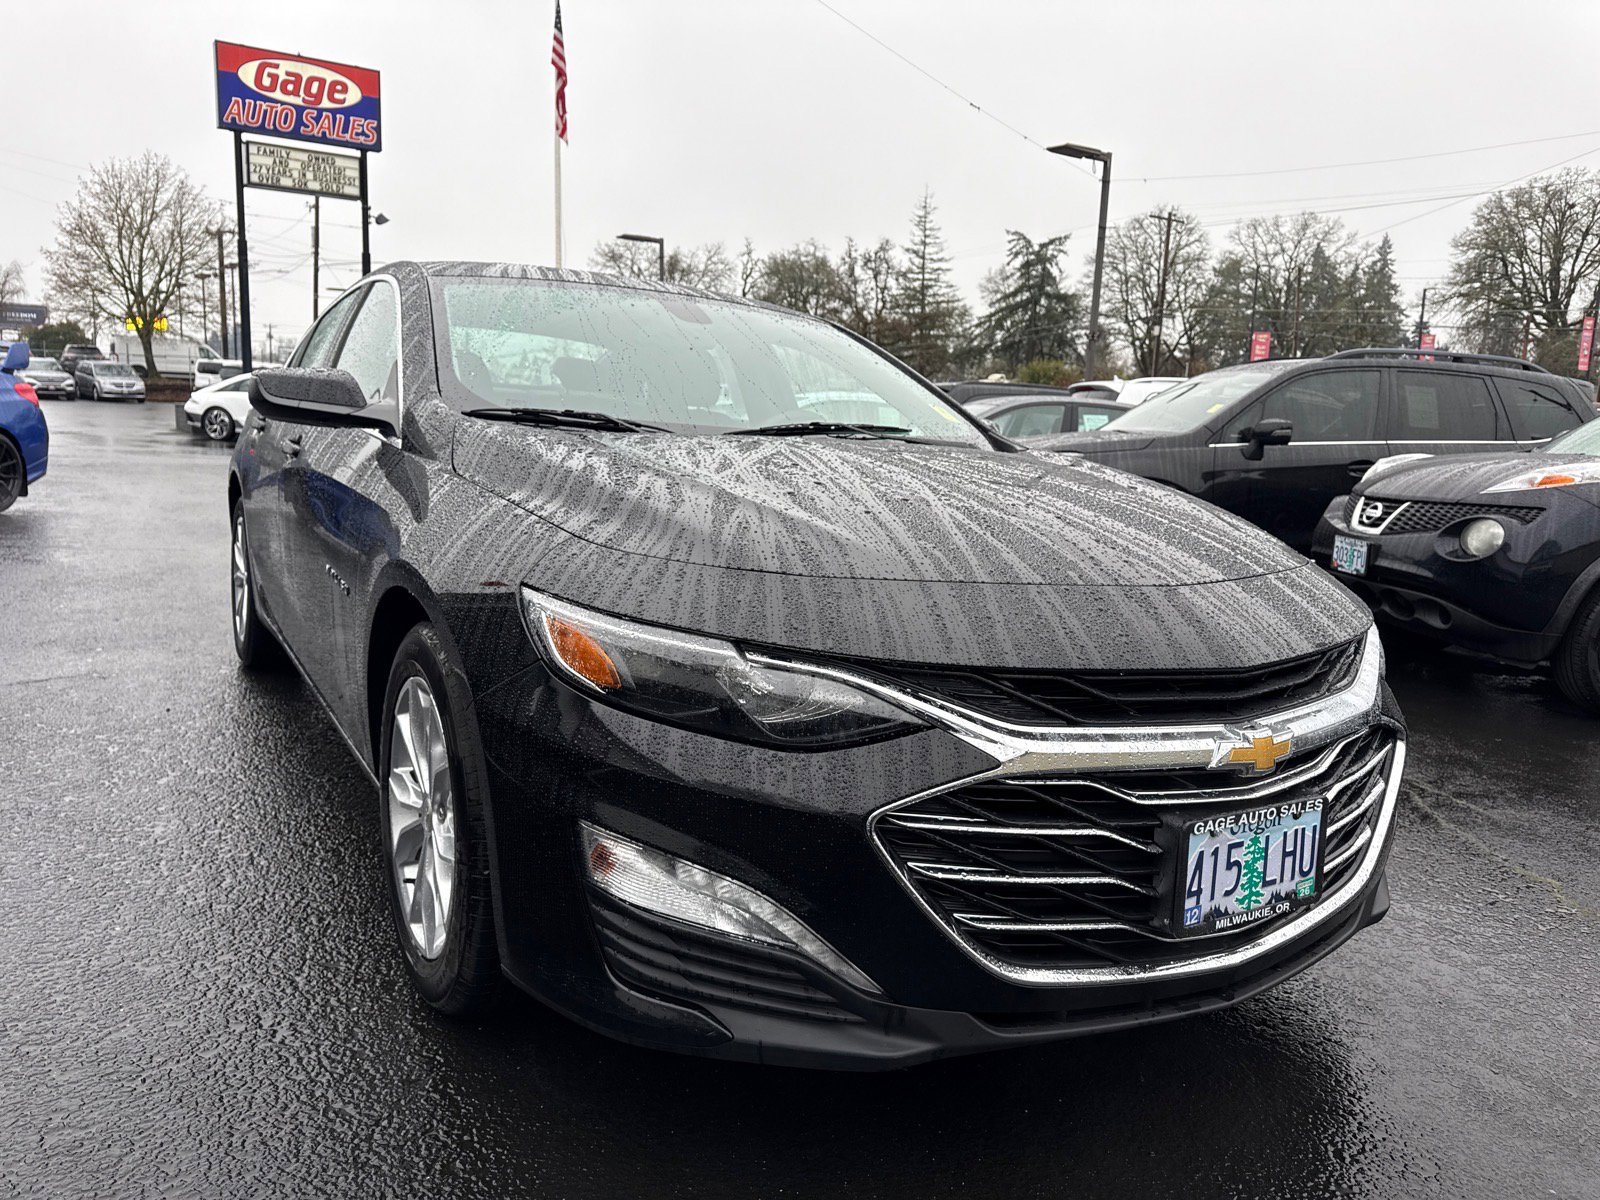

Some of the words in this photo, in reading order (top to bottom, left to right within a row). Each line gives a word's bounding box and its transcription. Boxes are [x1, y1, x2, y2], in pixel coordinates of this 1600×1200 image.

[253, 61, 349, 107] Gage
[223, 97, 296, 131] AUTO
[300, 109, 378, 145] SALES
[256, 146, 291, 159] FAMILY
[307, 154, 336, 166] OWNED
[265, 166, 293, 178] YEARS
[298, 170, 307, 179] IN
[313, 172, 356, 187] BUSINESS!
[272, 158, 290, 168] AND
[300, 161, 346, 176] OPERATED!
[257, 174, 281, 185] OVER
[319, 182, 345, 194] SOLD!
[1333, 545, 1348, 563] 303
[1193, 815, 1236, 835] GAGE
[1238, 807, 1277, 825] AUTO
[1280, 799, 1323, 816] SALES
[1186, 840, 1245, 906] 415
[1261, 824, 1318, 888] LHU
[1299, 886, 1311, 897] 26
[1185, 908, 1199, 926] 12
[1215, 907, 1273, 930] MILWAUKIE,
[1275, 902, 1290, 914] OR
